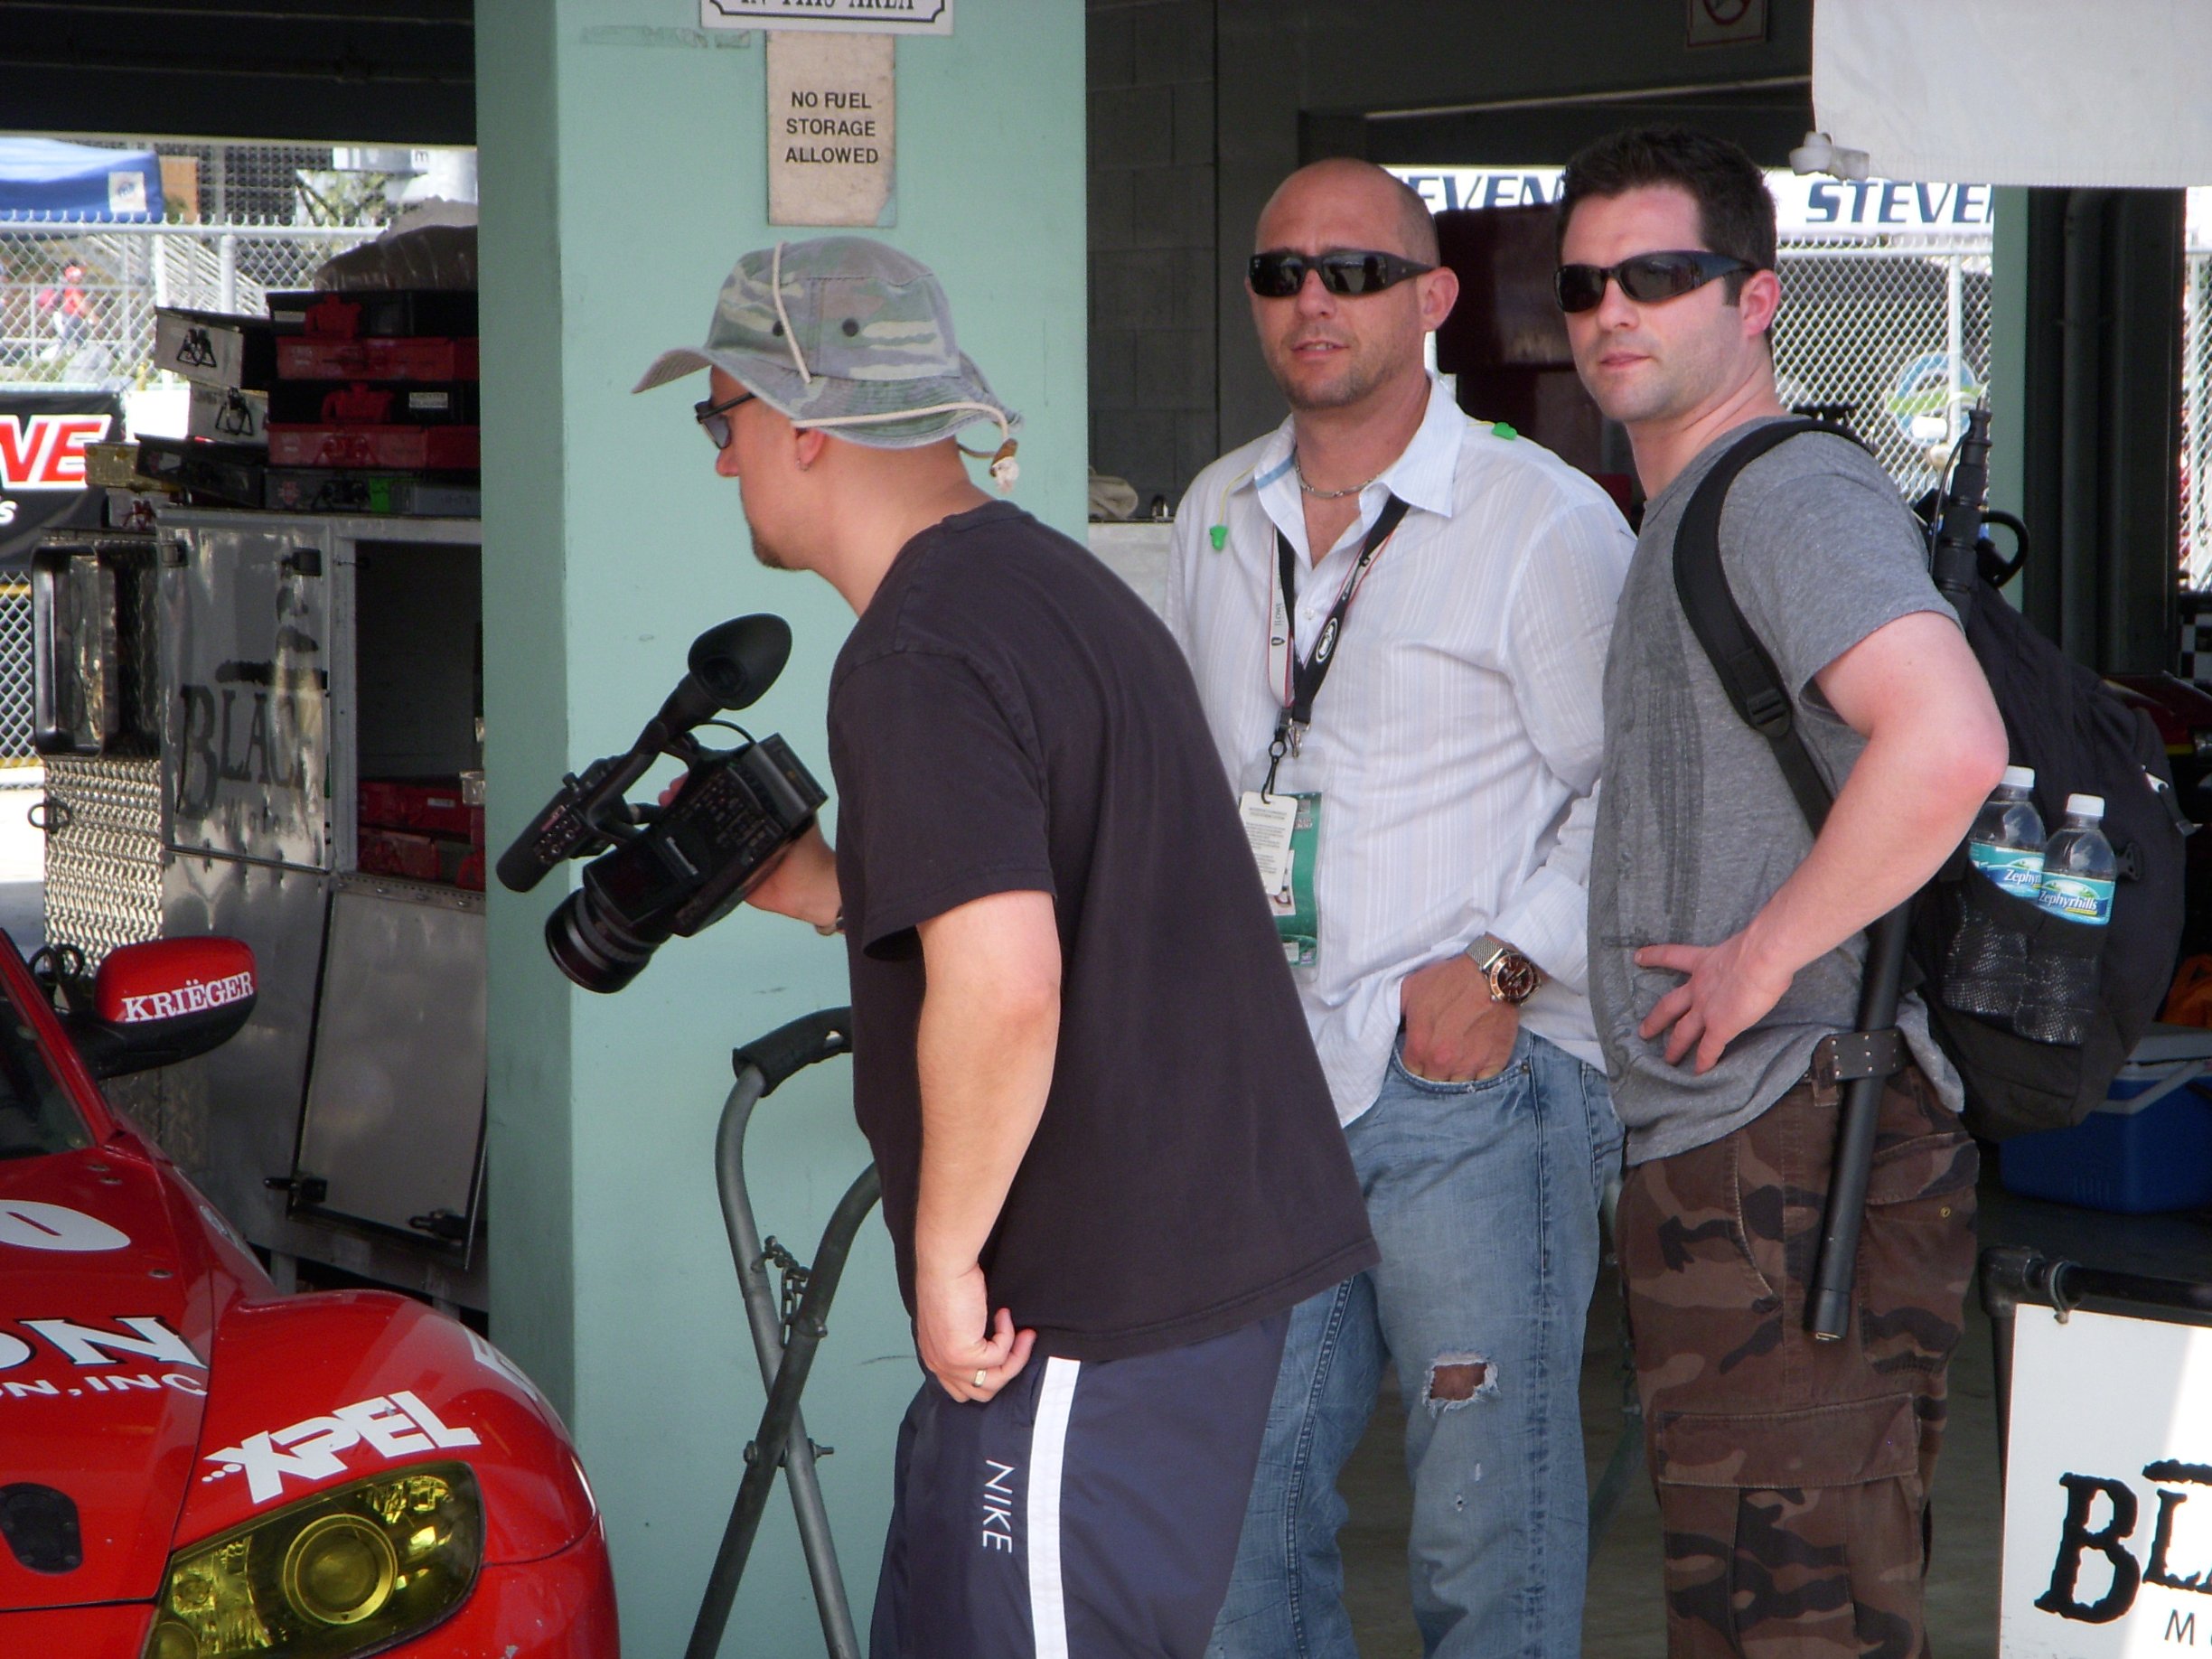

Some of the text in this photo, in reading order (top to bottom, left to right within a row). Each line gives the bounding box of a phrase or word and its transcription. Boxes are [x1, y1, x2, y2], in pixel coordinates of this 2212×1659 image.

[792, 91, 872, 108] NO FUEL
[786, 118, 876, 136] STORAGE
[785, 147, 879, 164] ALLOWED
[1399, 175, 1561, 210] EVEN
[2039, 890, 2098, 910] Zephyrhills
[121, 970, 254, 1023] KRIËGER
[202, 1391, 482, 1504] XPEL
[983, 1459, 1015, 1553] NIKE
[2034, 1472, 2212, 1624] BL
